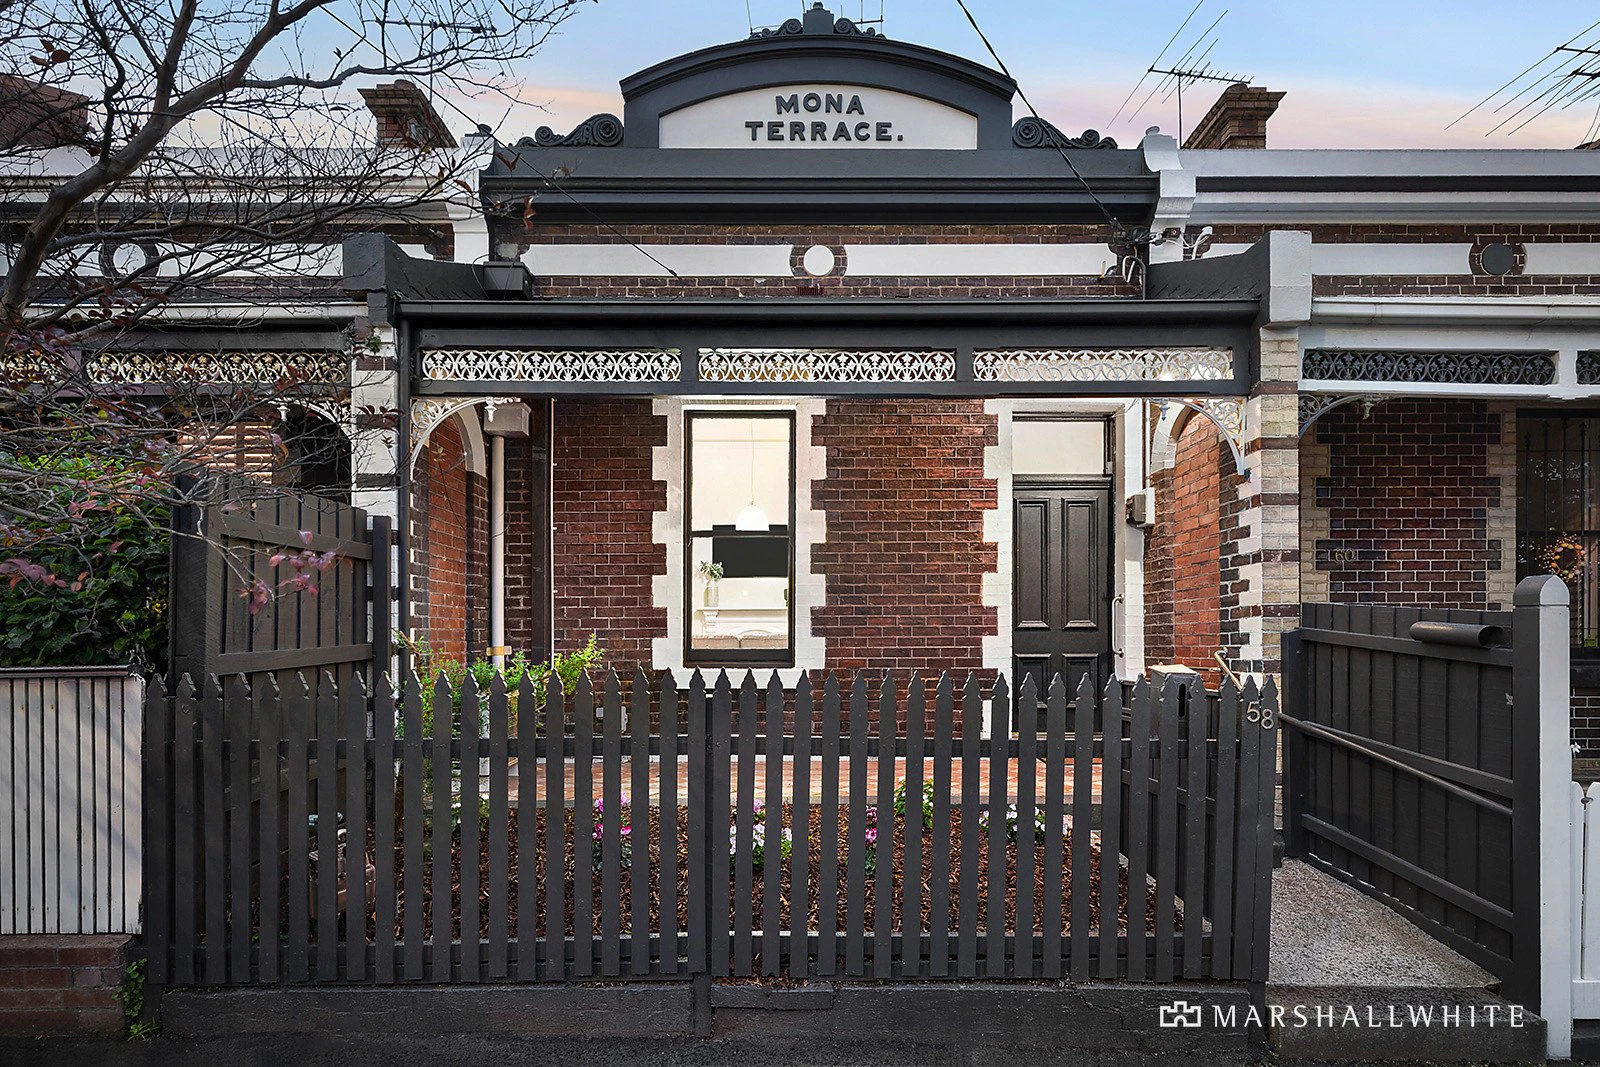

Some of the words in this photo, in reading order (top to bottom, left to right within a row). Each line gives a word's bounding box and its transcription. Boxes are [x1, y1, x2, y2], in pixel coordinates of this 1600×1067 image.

[775, 92, 865, 115] MONA
[745, 121, 904, 142] TERRACE.
[1335, 548, 1355, 563] 60
[1247, 701, 1274, 729] 58
